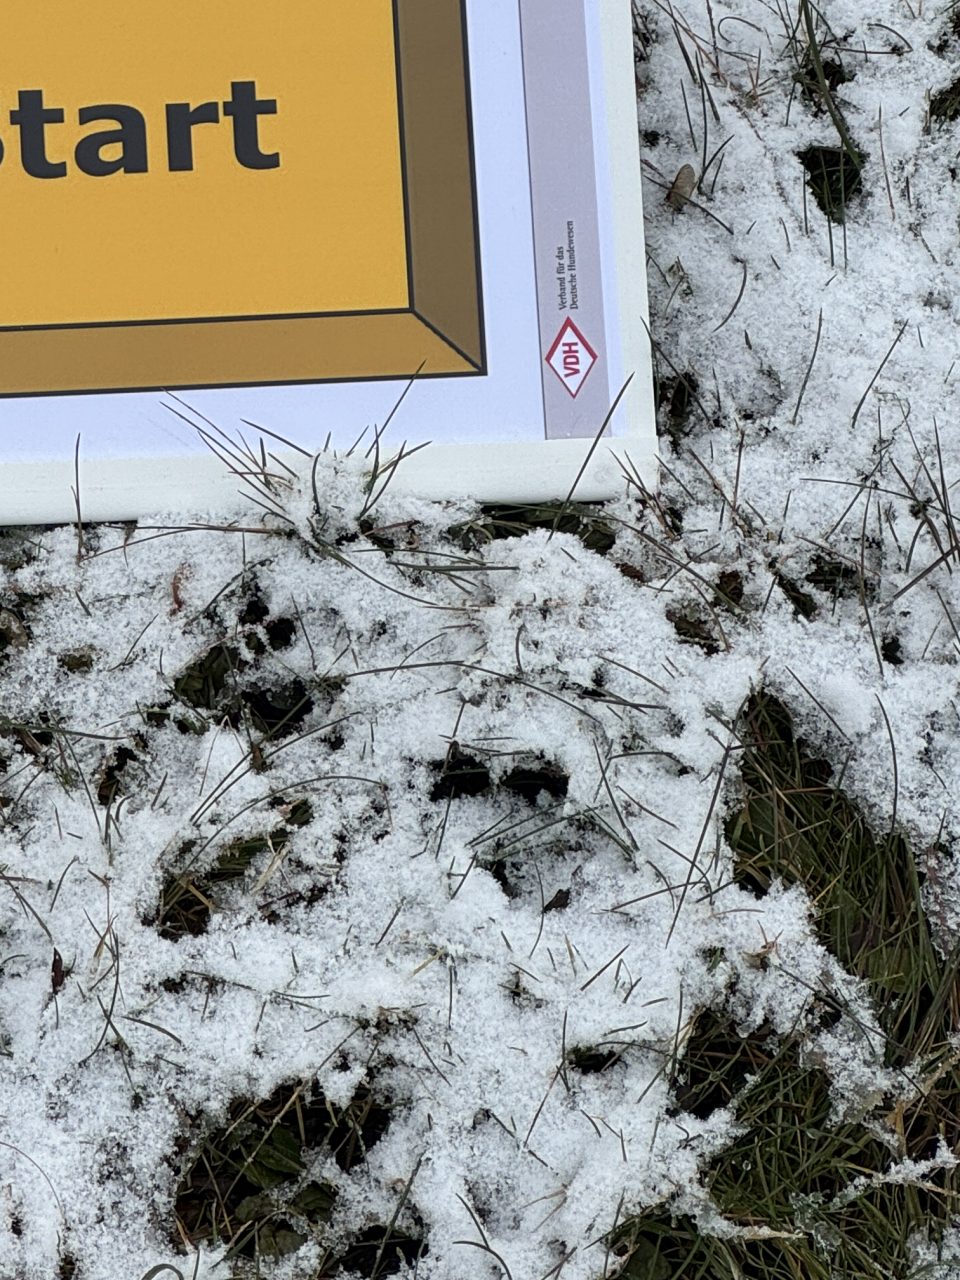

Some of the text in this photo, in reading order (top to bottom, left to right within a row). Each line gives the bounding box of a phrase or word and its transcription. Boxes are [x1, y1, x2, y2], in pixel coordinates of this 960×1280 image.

[555, 246, 567, 310] Verband für das
[566, 220, 579, 310] Deutsche Hundewesen
[562, 342, 580, 378] VDH
